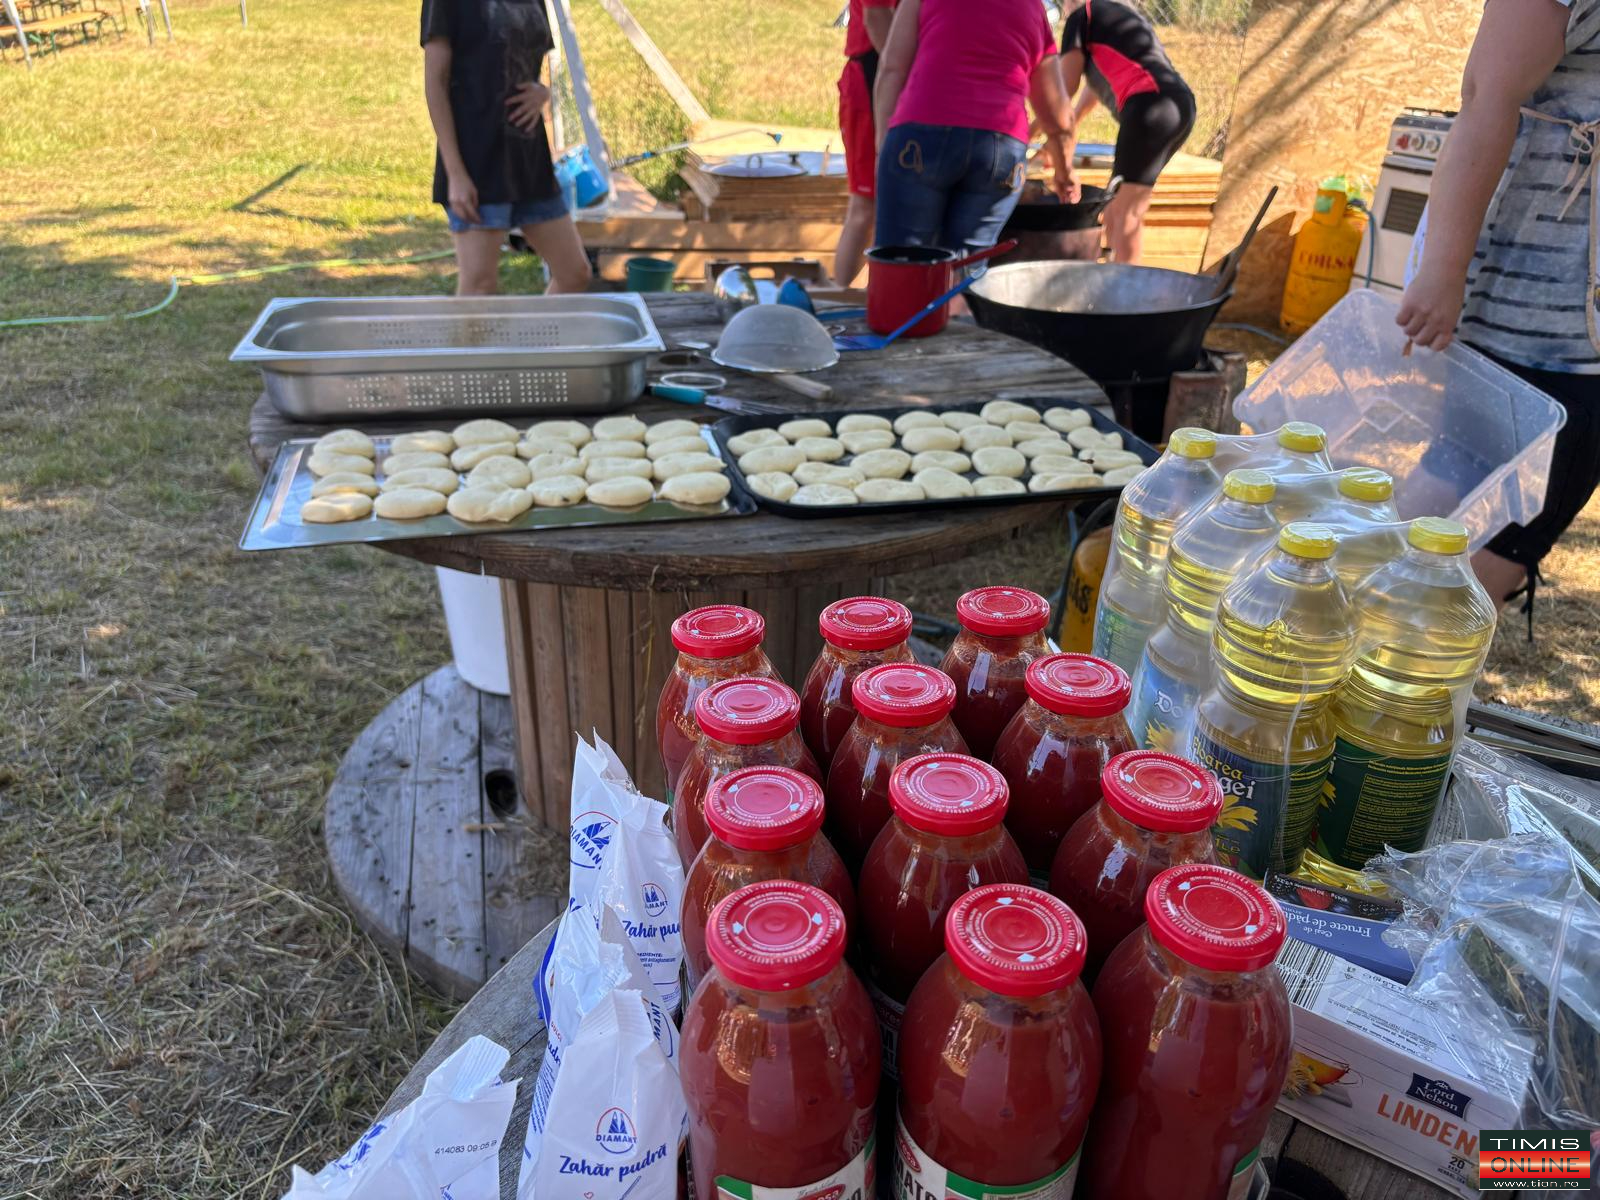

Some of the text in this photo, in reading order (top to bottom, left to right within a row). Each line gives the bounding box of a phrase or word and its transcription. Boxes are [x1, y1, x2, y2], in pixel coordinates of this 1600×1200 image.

[1312, 918, 1326, 930] de
[1330, 921, 1371, 937] Fructe
[1315, 928, 1333, 938] Ceai
[1415, 1087, 1458, 1111] Nelson
[1424, 1083, 1454, 1101] Lord
[1377, 1093, 1477, 1157] LINDEN
[596, 1134, 637, 1144] DIAMANT
[434, 1145, 465, 1155] 414083
[559, 1155, 614, 1177] Zahăr
[619, 1143, 667, 1182] pudră
[1449, 1156, 1465, 1170] 20
